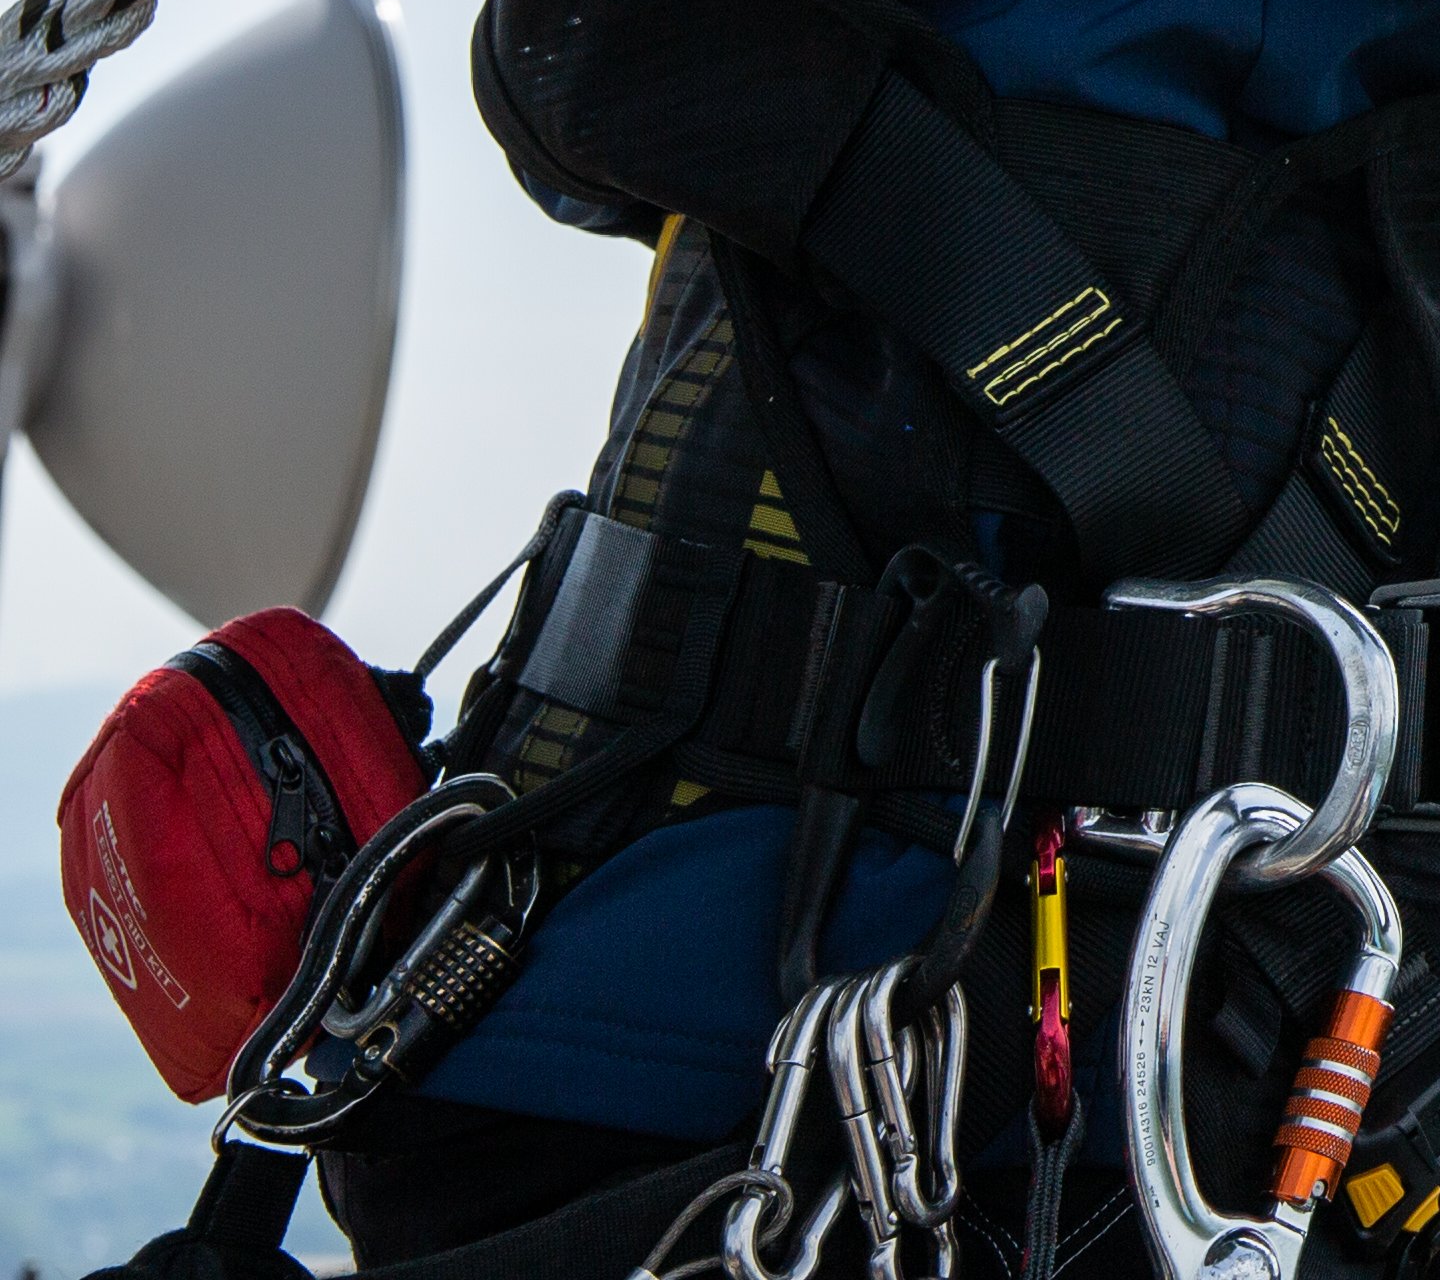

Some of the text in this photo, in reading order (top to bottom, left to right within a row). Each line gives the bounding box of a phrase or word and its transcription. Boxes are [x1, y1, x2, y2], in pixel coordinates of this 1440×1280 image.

[100, 836, 173, 987] FIRST AID KIT
[1136, 921, 1170, 1167] 90014316 24526 23kN 12 VAJ
